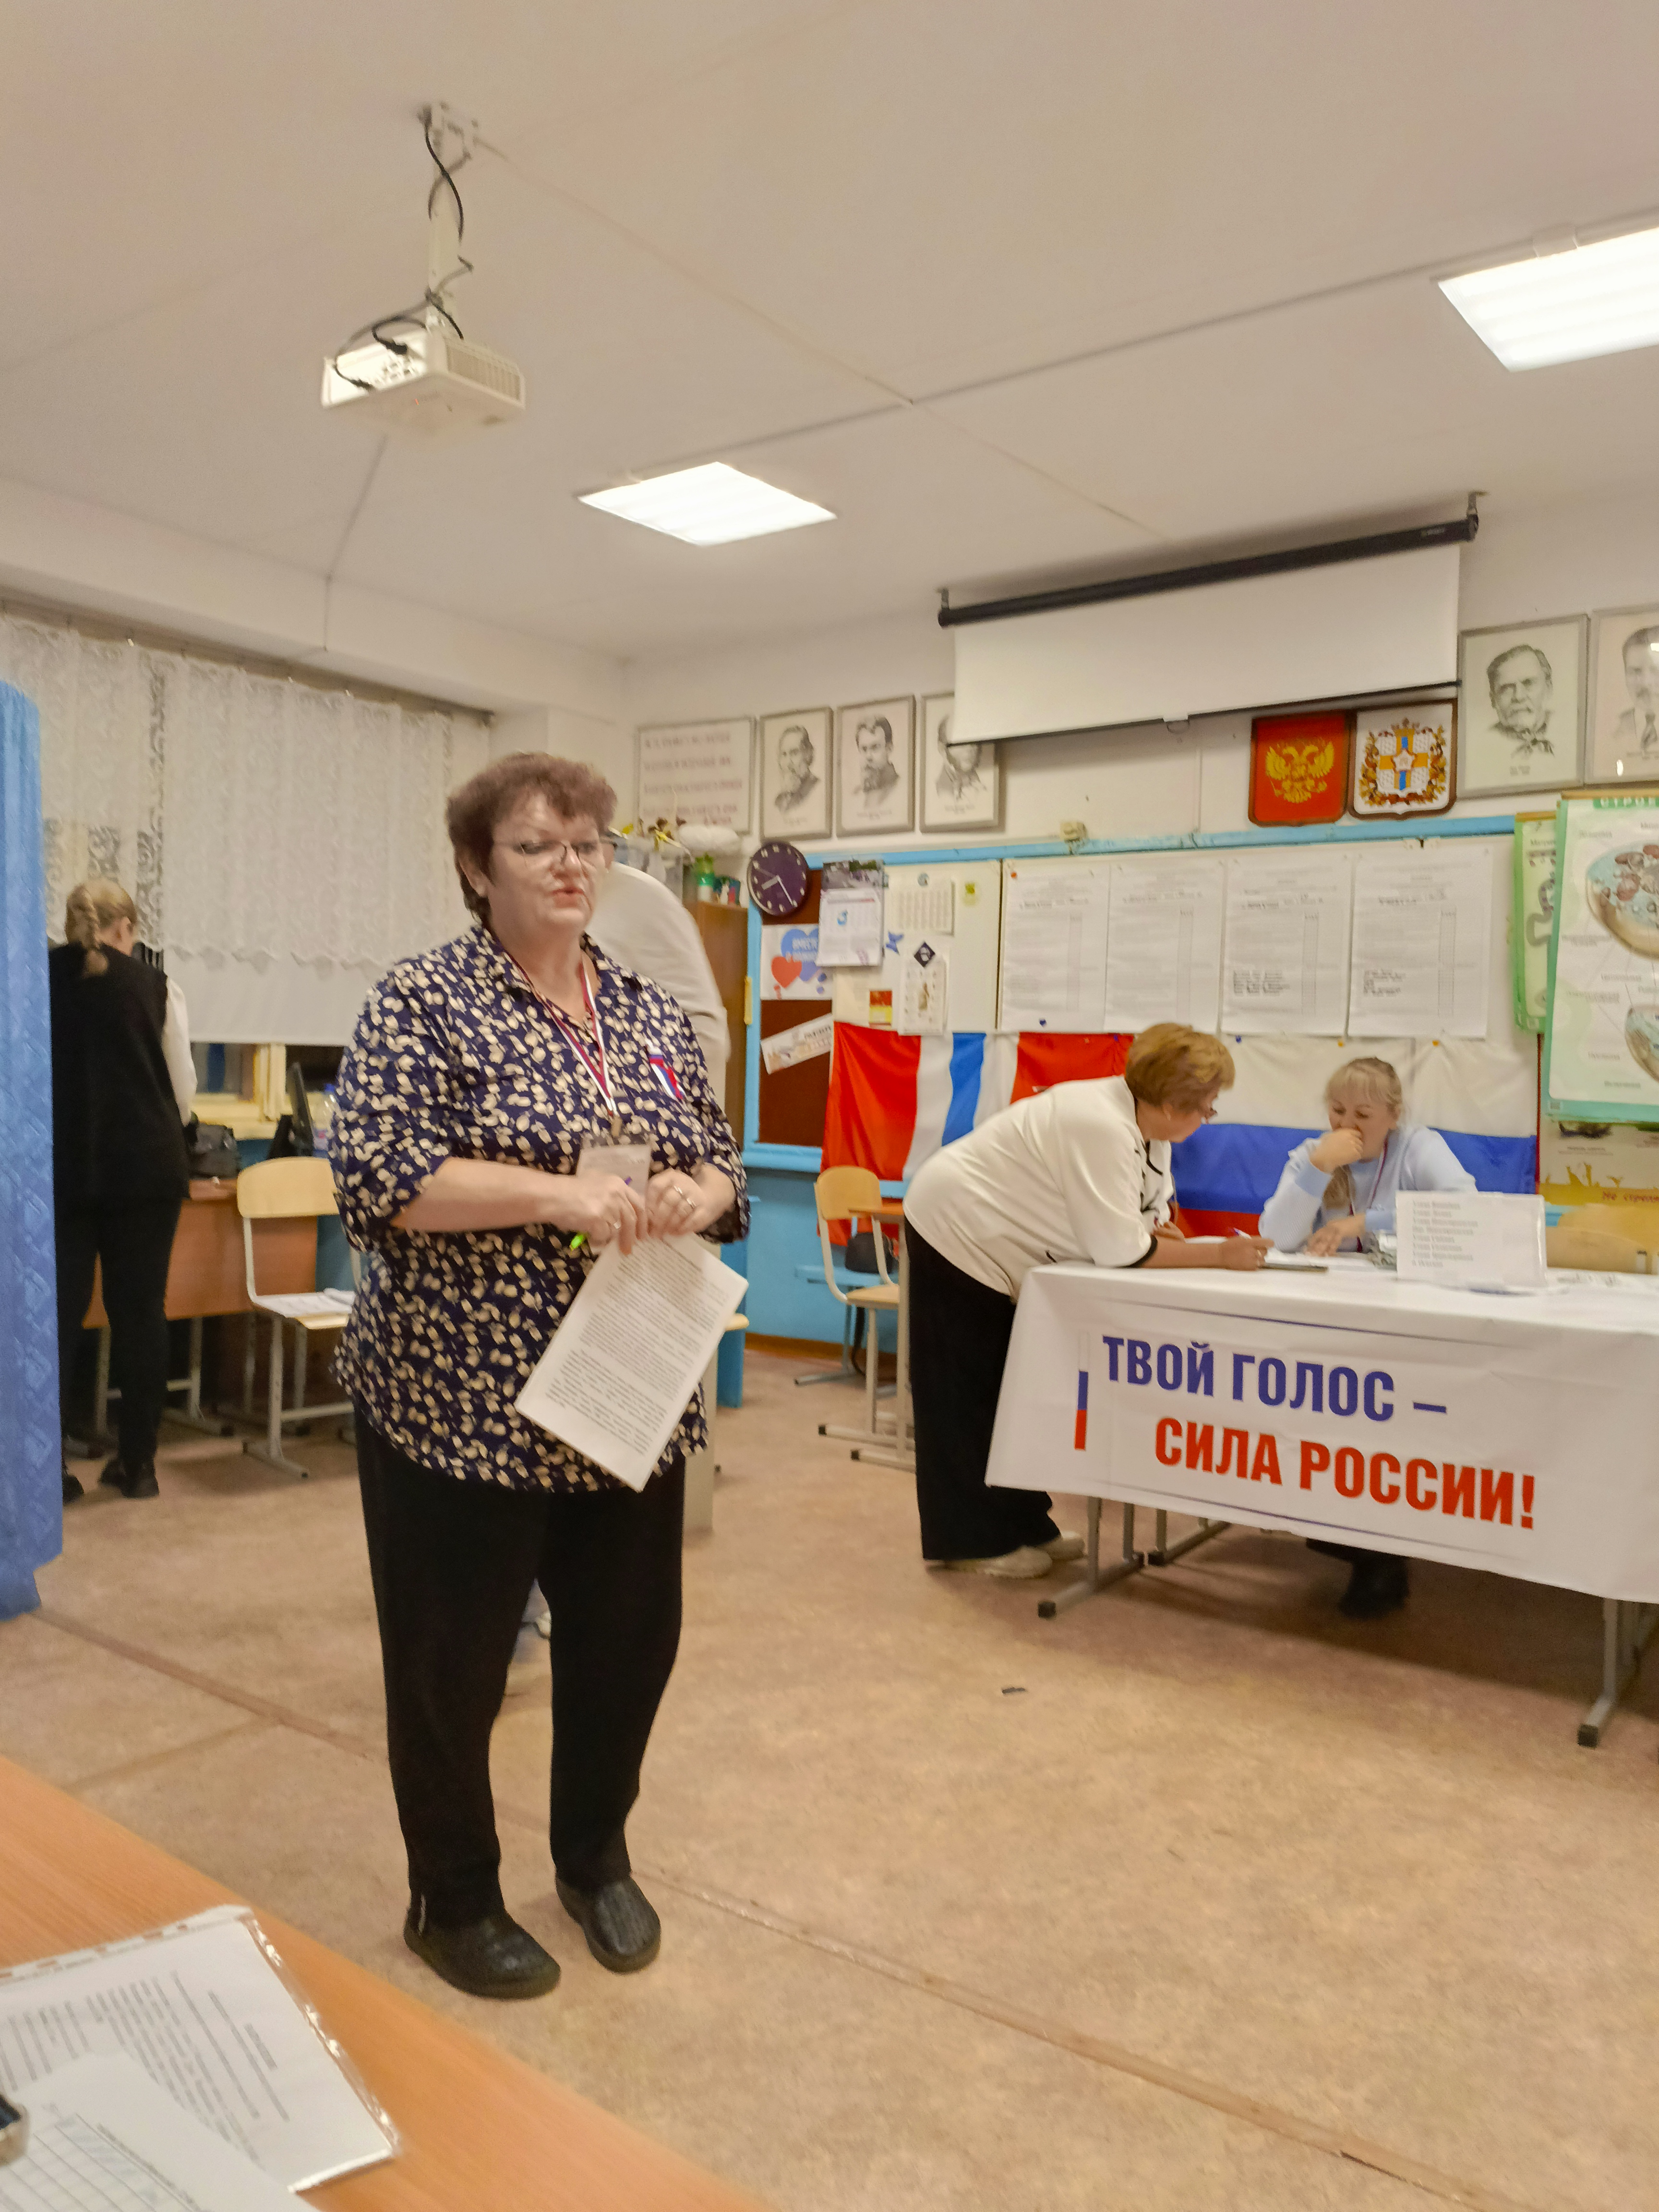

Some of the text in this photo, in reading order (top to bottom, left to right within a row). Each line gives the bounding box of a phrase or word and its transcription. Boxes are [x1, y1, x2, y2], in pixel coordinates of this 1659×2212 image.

[1102, 1335, 1214, 1397] ТВОЙ
[1232, 1353, 1394, 1422] ГОЛОС
[1154, 1417, 1535, 1530] СИЛА РОССИИ!
